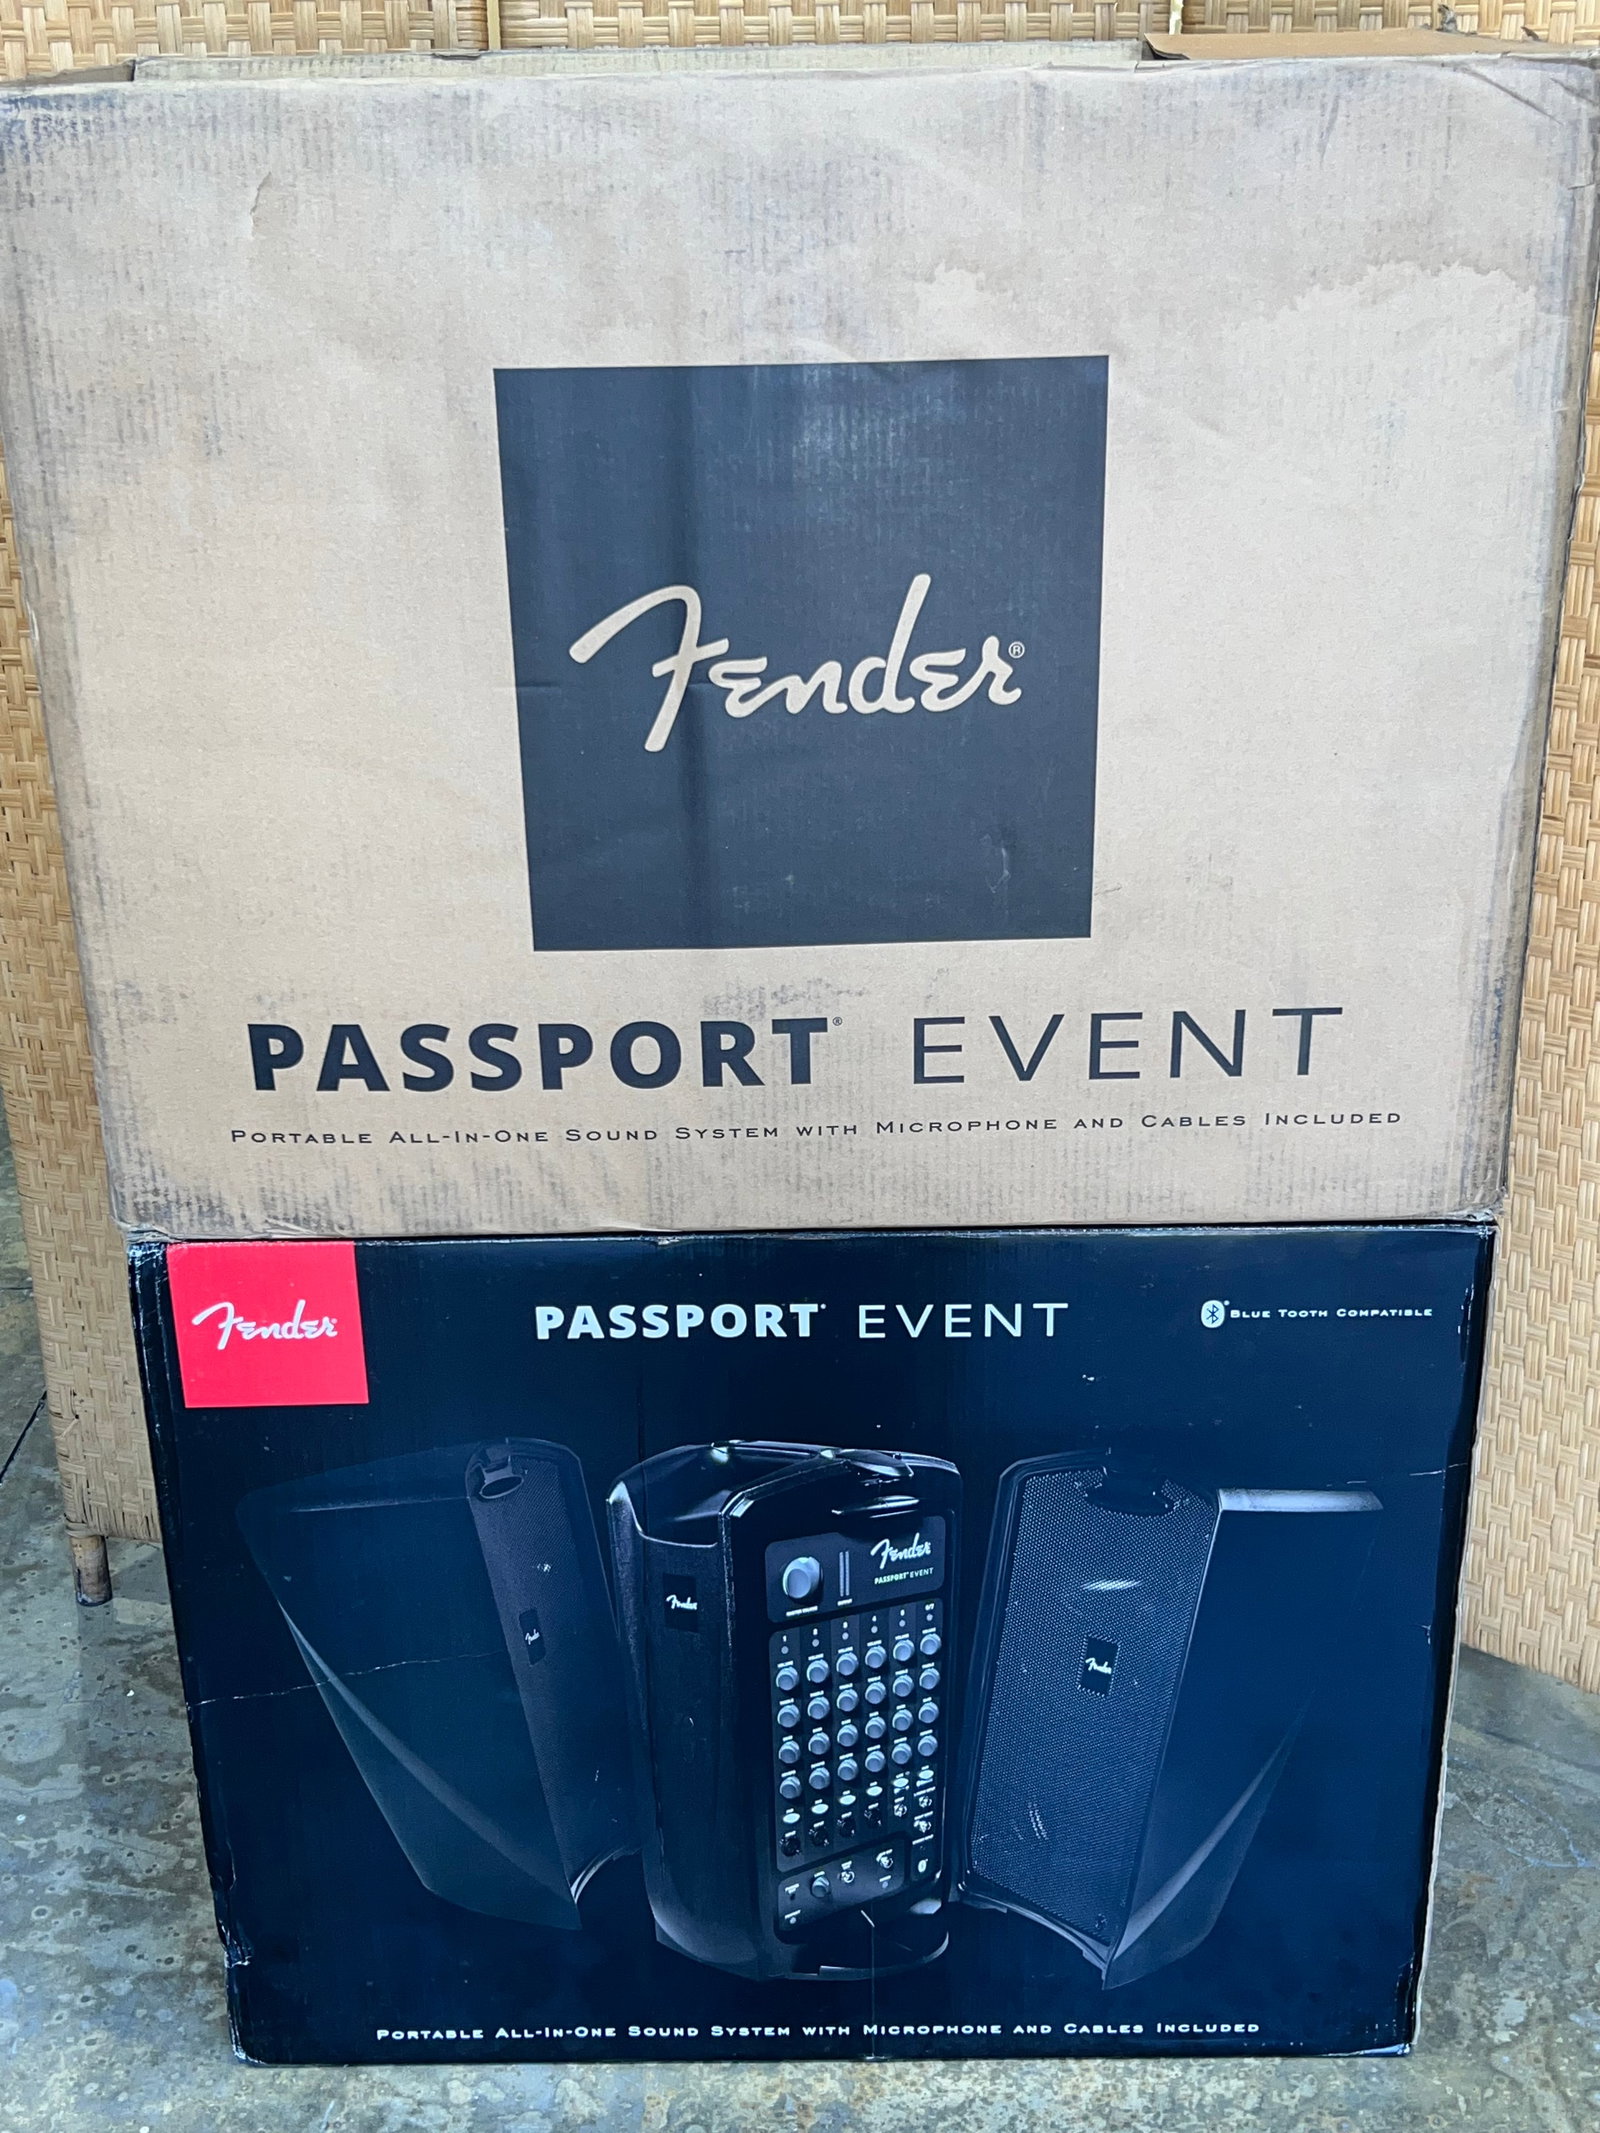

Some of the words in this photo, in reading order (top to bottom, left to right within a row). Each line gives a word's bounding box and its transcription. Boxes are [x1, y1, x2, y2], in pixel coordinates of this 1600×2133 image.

[913, 1006, 1343, 1085] EVENT
[231, 1129, 373, 1144] PORTABLE
[388, 1129, 549, 1144] ALL-IN-ONE
[565, 1128, 658, 1142] SOUND
[675, 1126, 778, 1140] SYSTEM
[795, 1124, 857, 1137] WITH
[876, 1119, 1057, 1135] MICROPHONE
[1073, 1117, 1123, 1129] AND
[1141, 1114, 1246, 1128] CABLES
[1265, 1112, 1401, 1126] INCLUDED
[858, 1302, 1069, 1339] EVENT
[1230, 1309, 1271, 1319] BLUE
[1277, 1309, 1328, 1318] TOOTH
[1336, 1308, 1433, 1318] COMPATIBLE
[870, 1532, 931, 1569] Fender
[909, 1567, 934, 1579] EVENT
[376, 2029, 484, 2041] PORTABLE
[495, 2026, 617, 2039] ALL-IN-ONE
[628, 2025, 699, 2037] SOUND
[710, 2025, 790, 2037] SYSTEM
[802, 2026, 850, 2036] WITH
[863, 2024, 1002, 2036] MICROPHONE
[1012, 2024, 1052, 2034] AND
[1063, 2023, 1144, 2034] CABLES
[1156, 2022, 1260, 2033] INCLUDED
